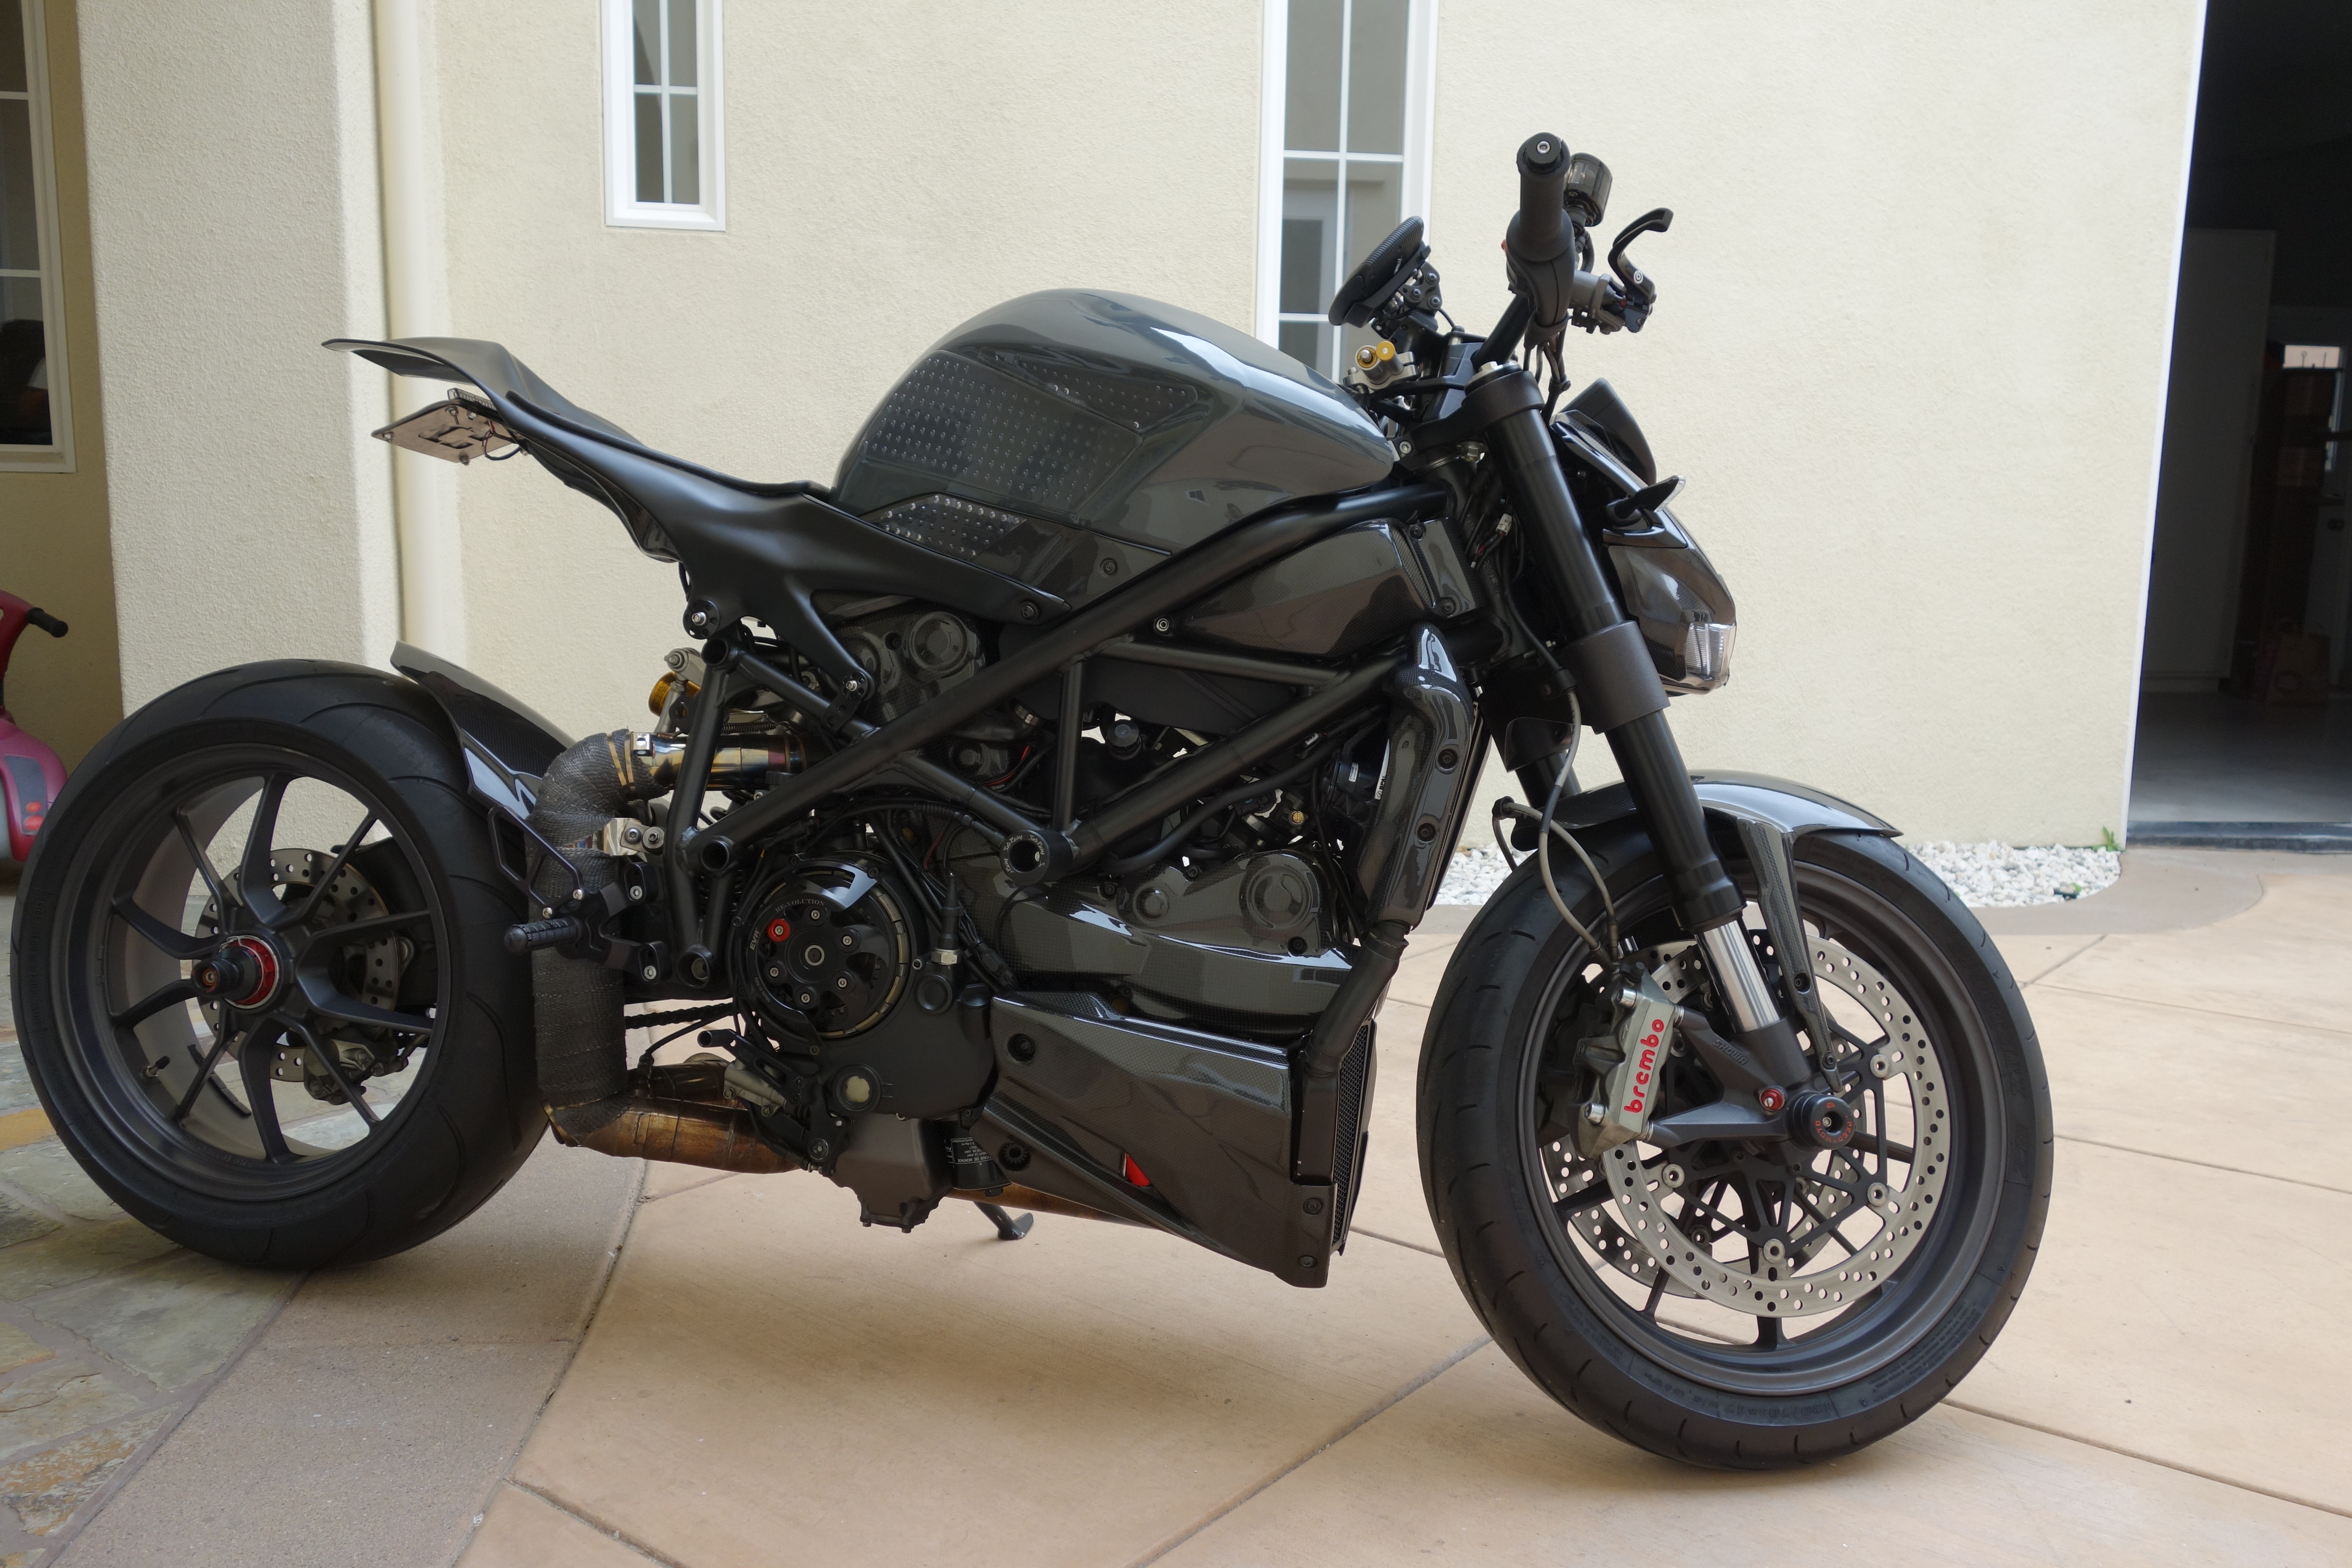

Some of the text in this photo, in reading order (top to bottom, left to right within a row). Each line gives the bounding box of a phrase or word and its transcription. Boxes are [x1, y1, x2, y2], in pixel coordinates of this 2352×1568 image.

[750, 930, 760, 950] EVR
[1713, 1039, 1748, 1065] SHOWA
[1624, 1019, 1665, 1113] brembo
